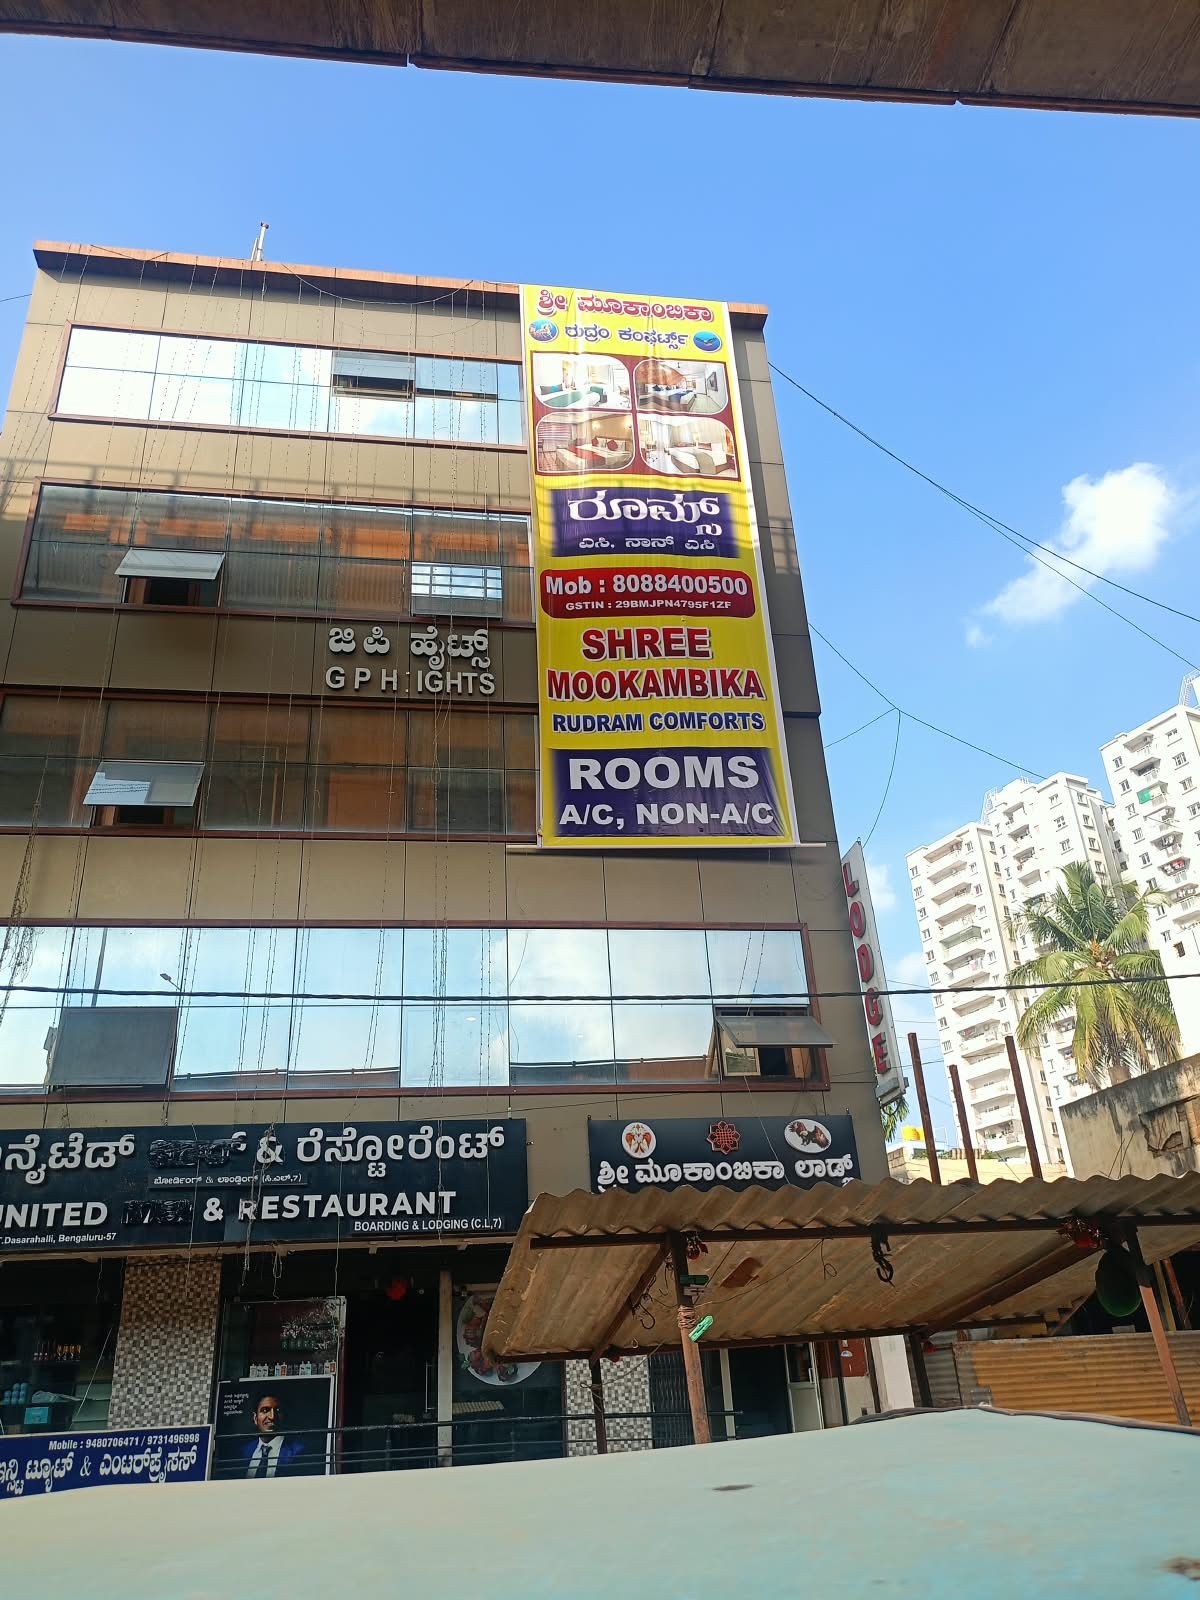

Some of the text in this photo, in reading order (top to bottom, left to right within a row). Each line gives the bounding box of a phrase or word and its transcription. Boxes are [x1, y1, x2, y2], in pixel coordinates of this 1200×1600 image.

[537, 289, 714, 322] ಶ್ರೀ ಮೂಕಾಂಬಿಕಾ
[565, 324, 610, 342] ರುದ್ರಂ
[567, 489, 723, 536] ರೂಮ್ಸ್
[625, 536, 675, 548] ನಾನ್
[685, 539, 715, 551] ಎಸಿ
[545, 575, 592, 595] Mob
[612, 574, 748, 596] 8088400500
[565, 601, 605, 610] GSTIN
[615, 600, 732, 609] 29BMJPN4795F1ZF
[328, 625, 491, 670] ಜಿ ಪಿ ಹೈಟ್ಸ್
[582, 625, 713, 661] SHREE
[547, 667, 766, 702] MOOKAMBIKA
[552, 711, 765, 733] RUDRAM COMFORTS
[568, 755, 759, 790] ROOMS
[559, 802, 774, 830] A/C, NON-A/C
[842, 863, 891, 1075] LODGE
[0, 1132, 135, 1184] ನೈಟೆಡ್
[256, 1136, 283, 1164] &
[296, 1125, 505, 1178] ರೆಸ್ಟೋರೆಂಟ್
[206, 1175, 213, 1184] &
[597, 1160, 629, 1193] ಶ್ರೀ
[635, 1158, 785, 1184] ಮೂಕಾಂಬಿಕಾ
[0, 1200, 108, 1229] NITED
[203, 1198, 224, 1222] &
[238, 1191, 456, 1221] RESTAURANT
[58, 1232, 117, 1244] Bengaluru-57
[354, 1220, 408, 1231] BOARDING
[412, 1220, 420, 1230] &
[422, 1219, 469, 1230] LODGING
[49, 1439, 78, 1450] Mobile
[85, 1436, 139, 1448] 9480706471
[147, 1433, 200, 1445] 9731496998
[80, 1455, 91, 1477] &
